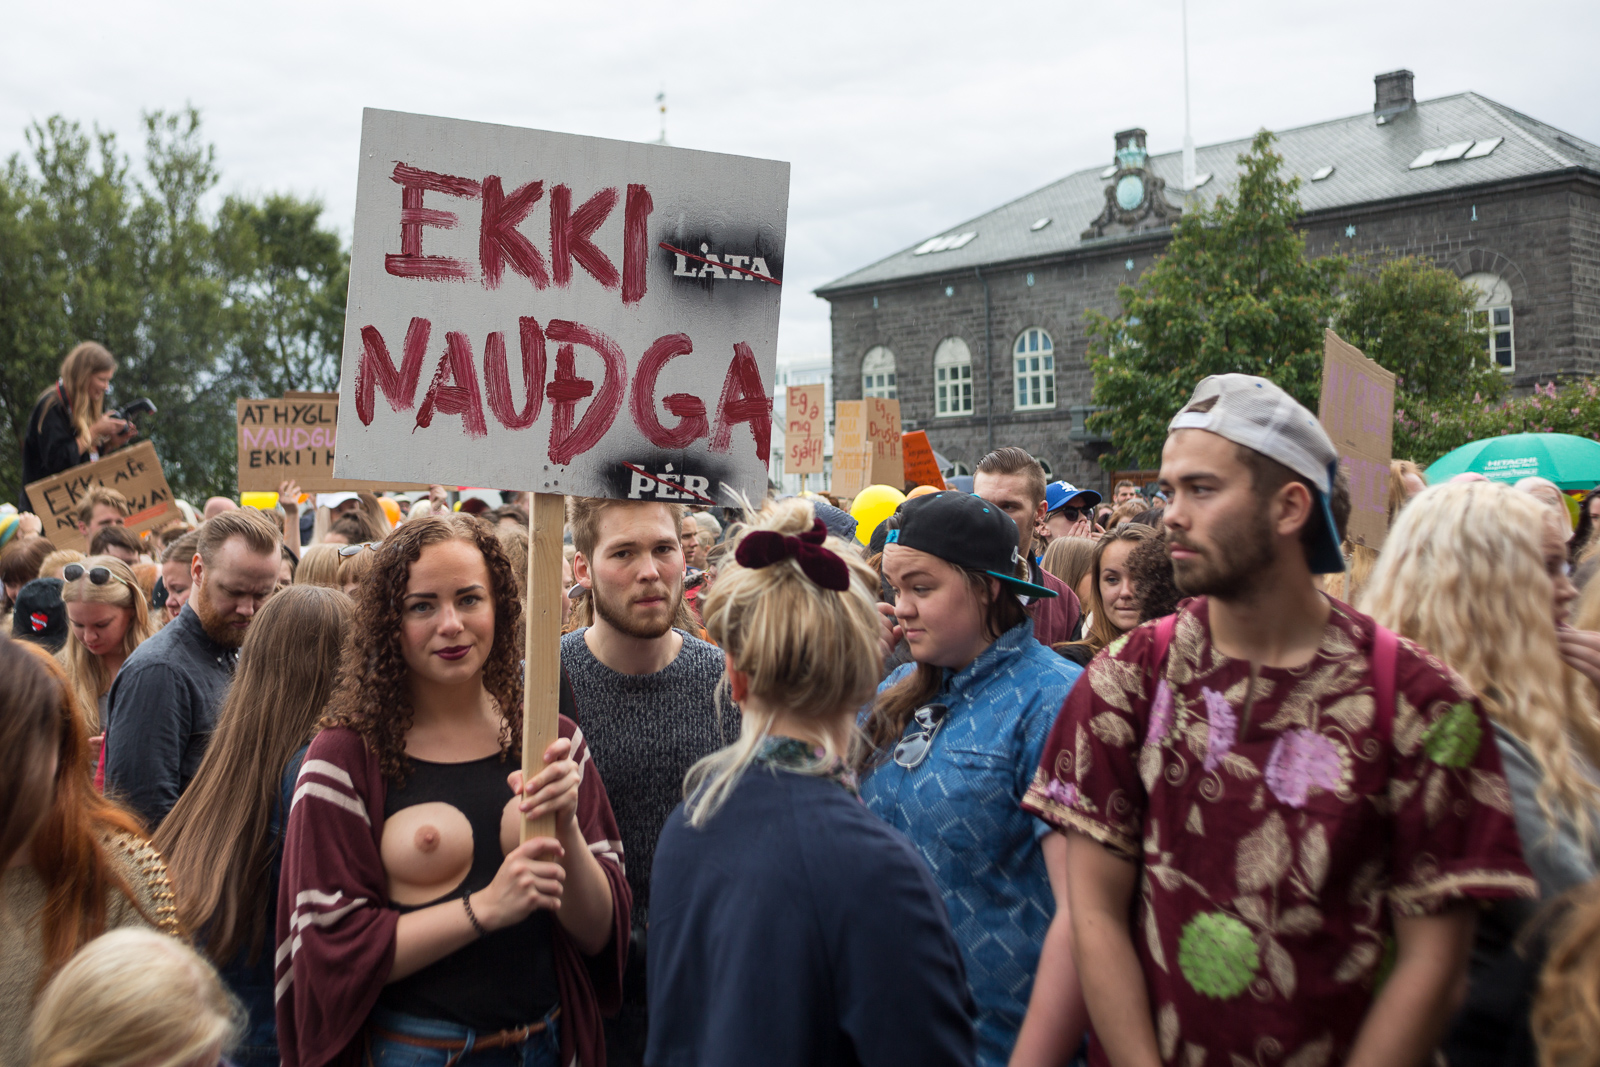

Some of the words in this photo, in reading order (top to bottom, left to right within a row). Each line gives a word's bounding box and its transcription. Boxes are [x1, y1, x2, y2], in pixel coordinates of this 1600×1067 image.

[384, 160, 653, 308] EKKI
[790, 420, 811, 443] mig
[250, 449, 300, 468] EKKI
[1487, 457, 1538, 466] HITACHI
